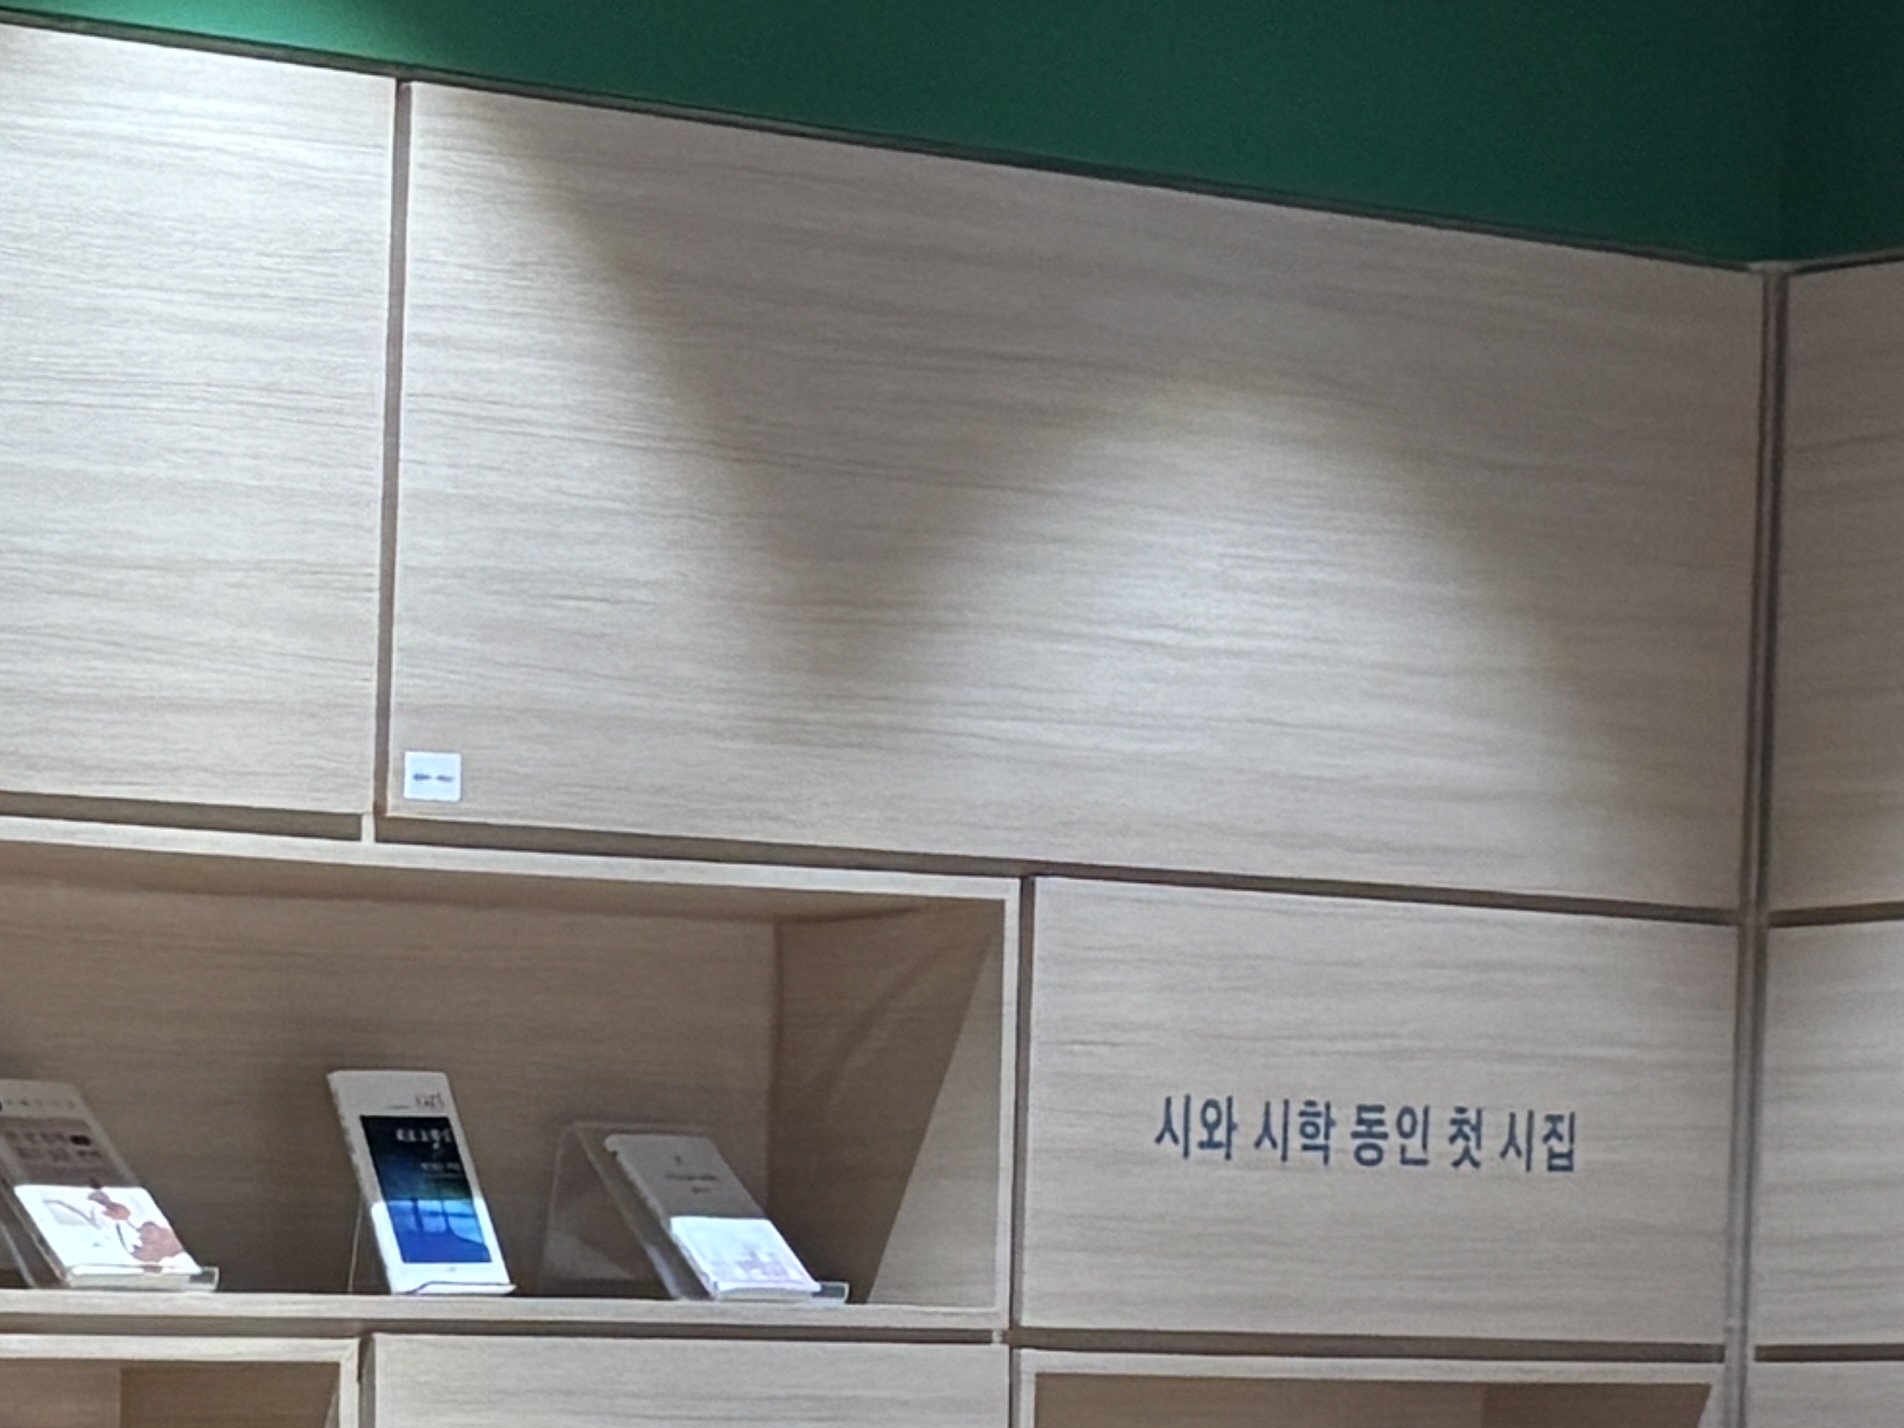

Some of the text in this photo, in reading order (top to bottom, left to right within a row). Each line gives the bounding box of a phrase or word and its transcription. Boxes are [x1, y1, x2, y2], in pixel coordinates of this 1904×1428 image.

[1154, 1094, 1577, 1174] 시와 시학 동인 첫 시집
